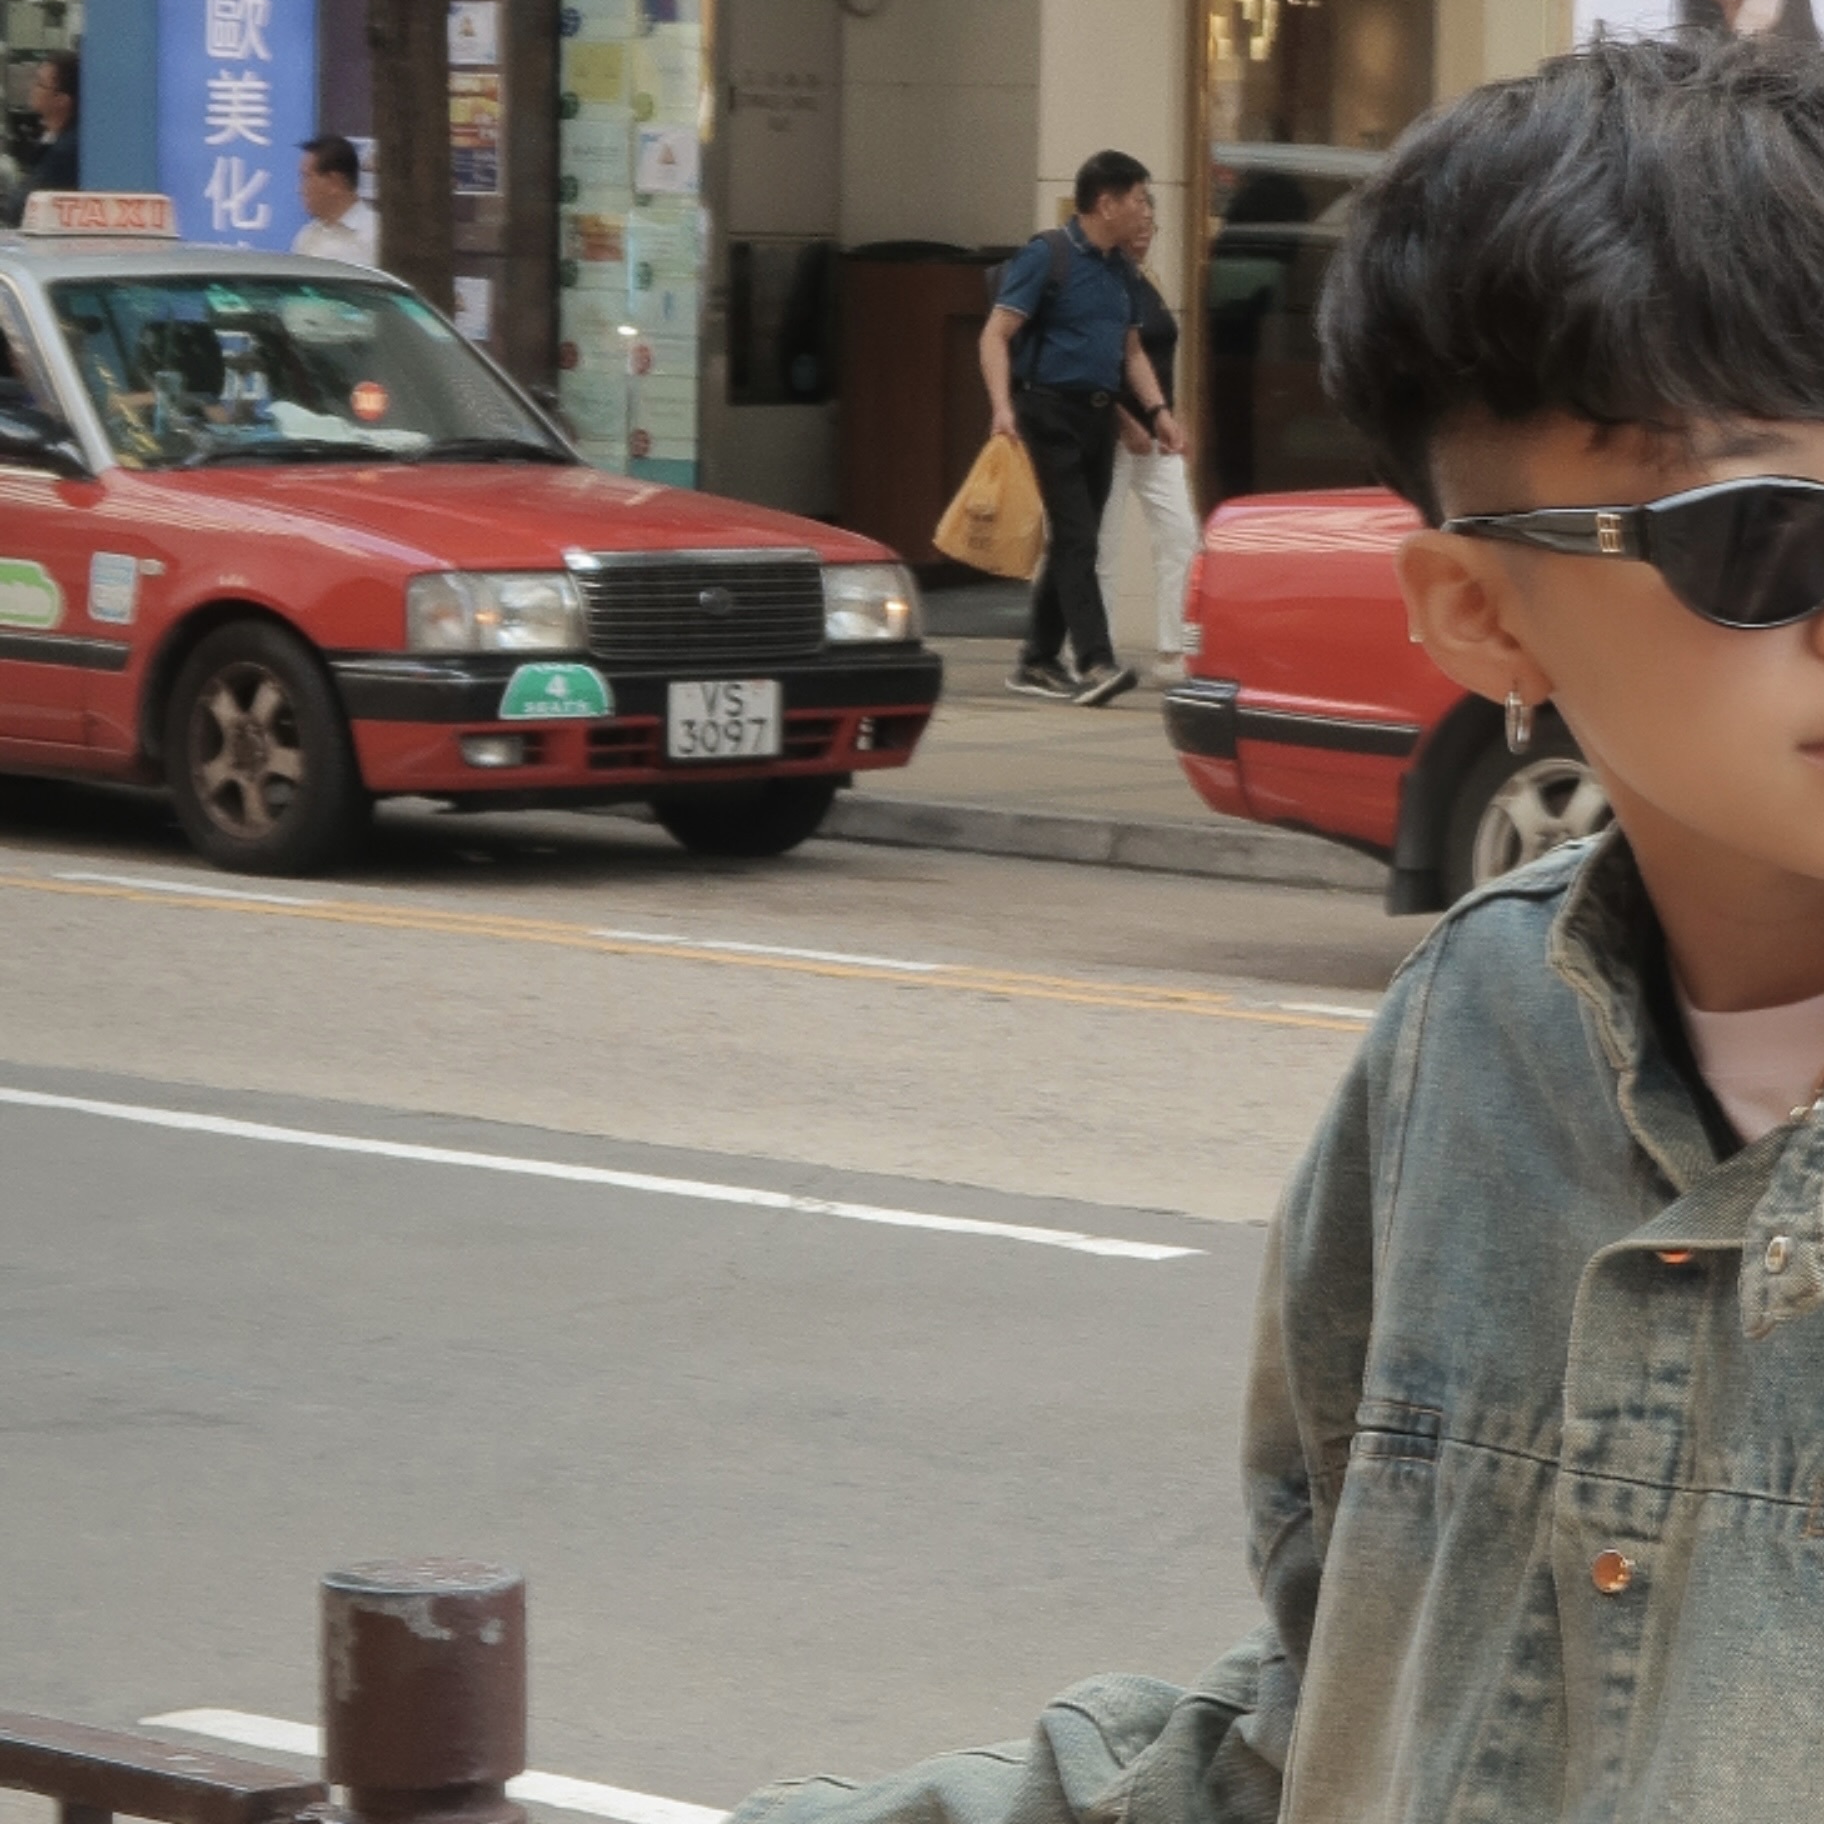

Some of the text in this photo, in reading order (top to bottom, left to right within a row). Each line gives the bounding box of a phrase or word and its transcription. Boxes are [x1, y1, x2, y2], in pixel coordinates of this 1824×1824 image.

[52, 196, 166, 229] TAXI
[545, 675, 569, 698] 4
[701, 684, 743, 717] VS
[678, 718, 766, 754] 3097
